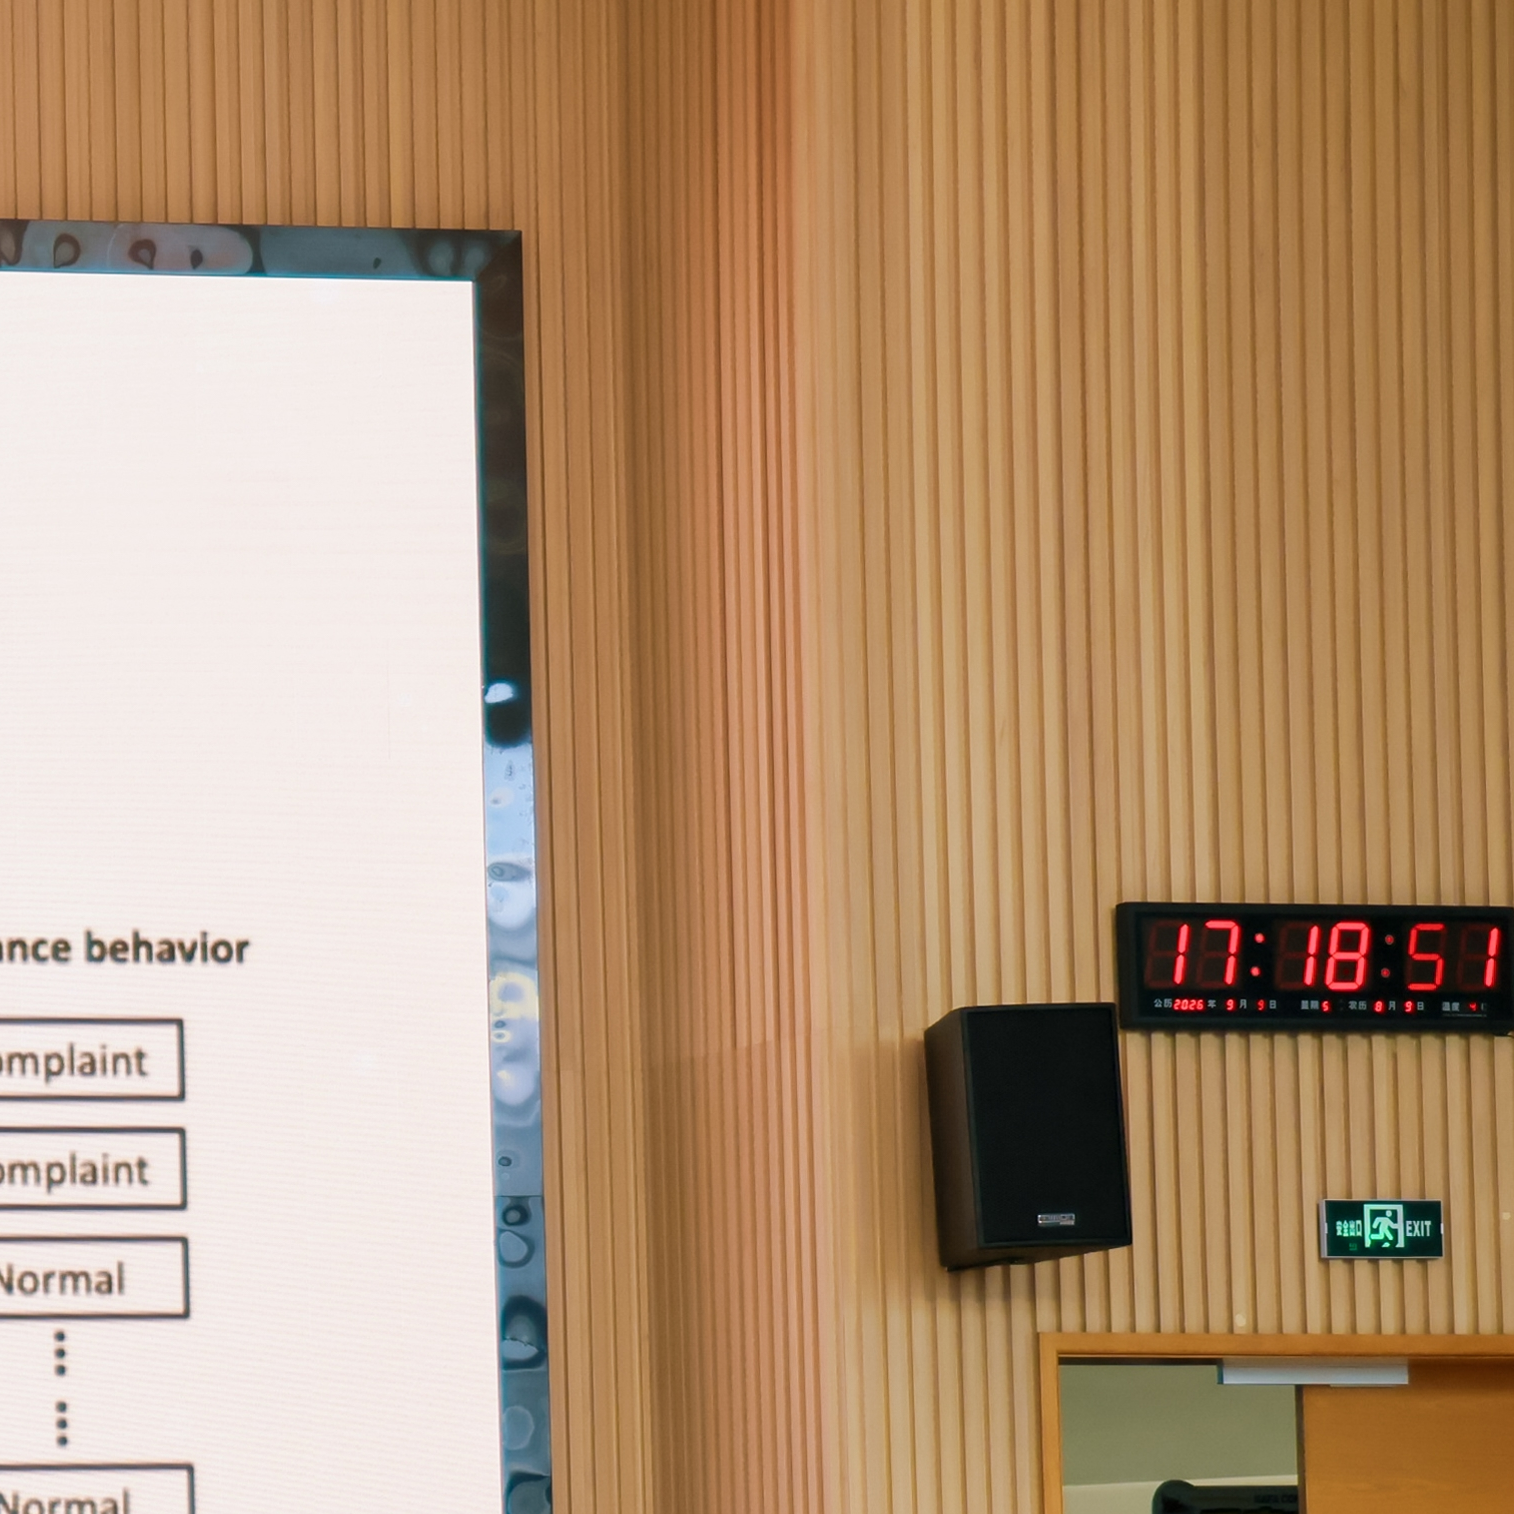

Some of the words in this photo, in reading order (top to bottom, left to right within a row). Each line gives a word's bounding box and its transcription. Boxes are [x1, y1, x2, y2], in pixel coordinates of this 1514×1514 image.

[84, 929, 251, 965] behavior
[1172, 919, 1501, 991] 17:18:51
[1335, 1219, 1363, 1237] 安全出口
[1405, 1220, 1432, 1237] EXIT
